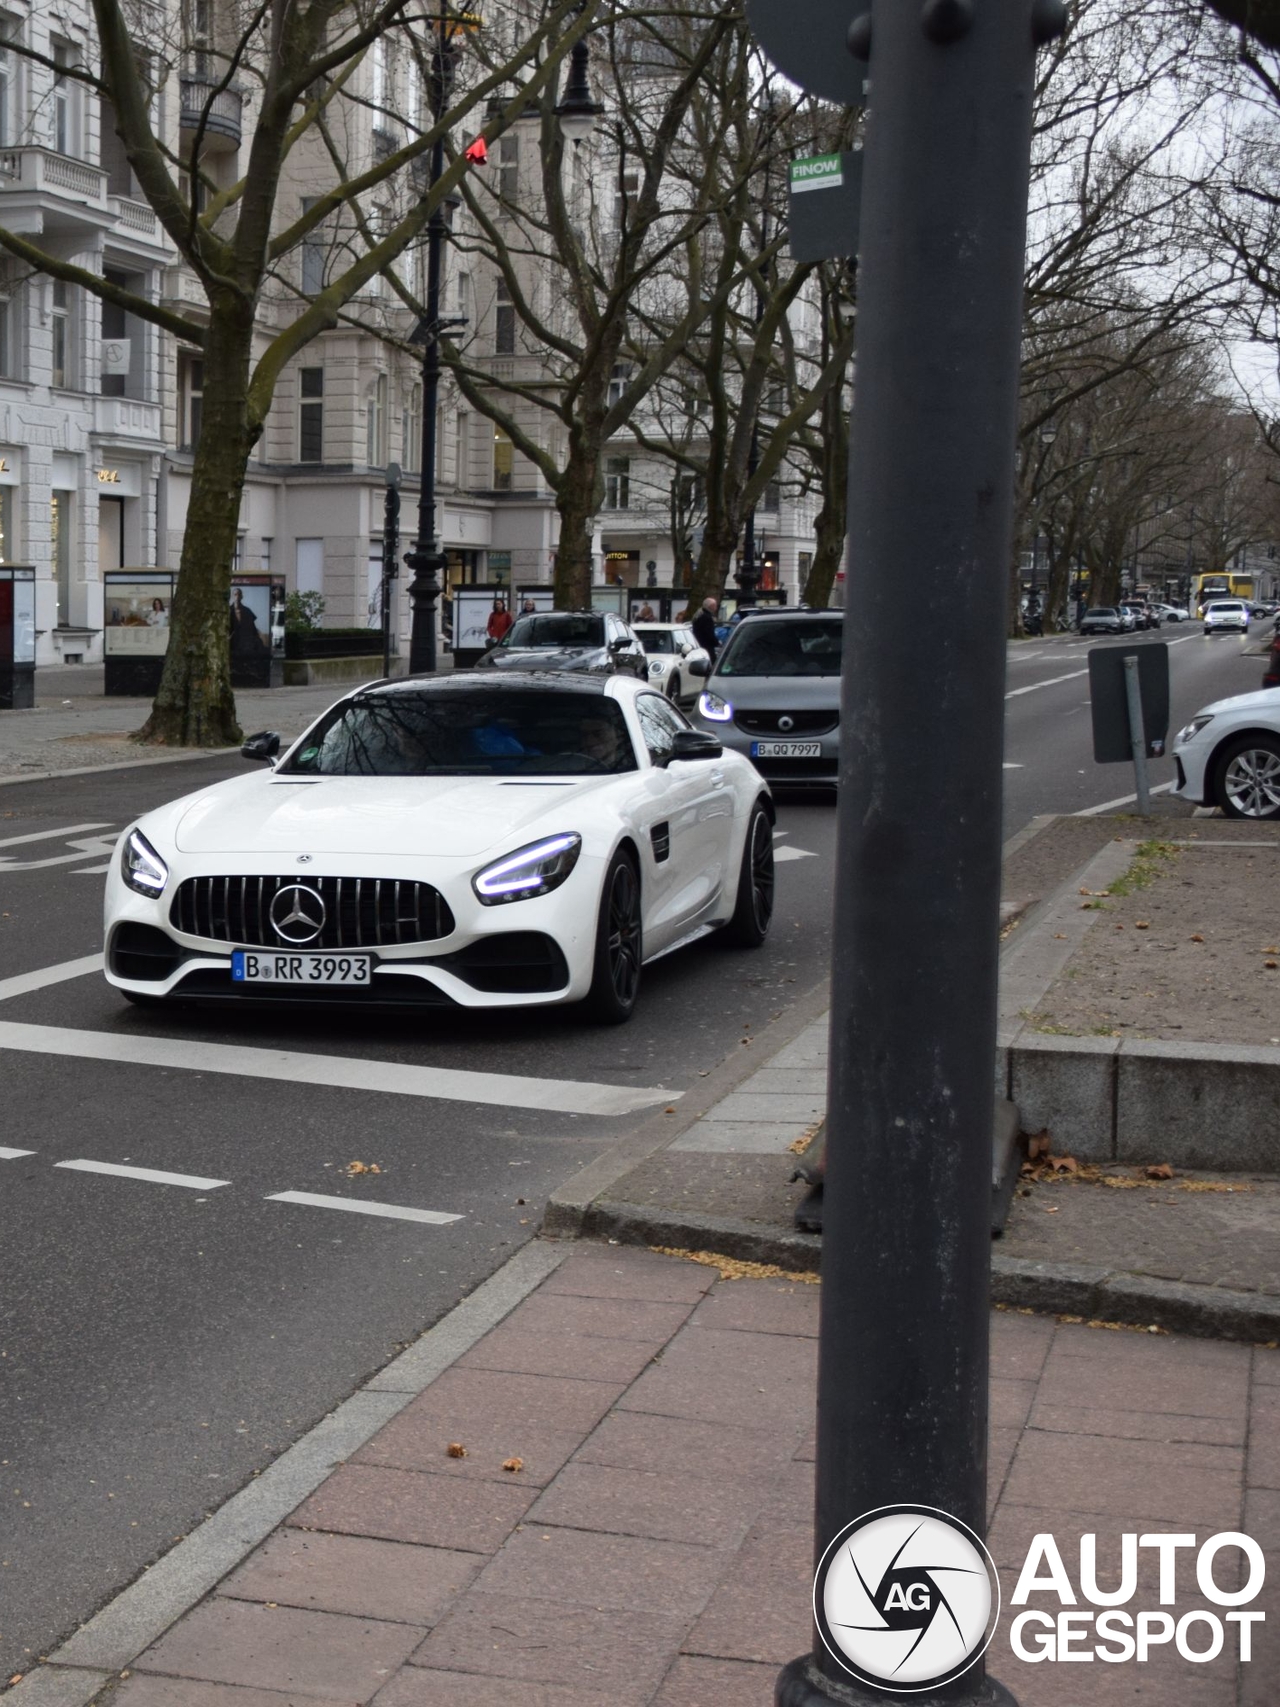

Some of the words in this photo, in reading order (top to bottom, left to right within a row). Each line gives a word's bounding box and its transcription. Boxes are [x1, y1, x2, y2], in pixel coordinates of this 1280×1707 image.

[792, 159, 838, 178] FINOW
[759, 744, 766, 755] B
[773, 744, 788, 756] QQ
[790, 744, 819, 755] 7997
[246, 956, 259, 978] B
[275, 957, 303, 979] RR
[309, 958, 367, 981] 3993
